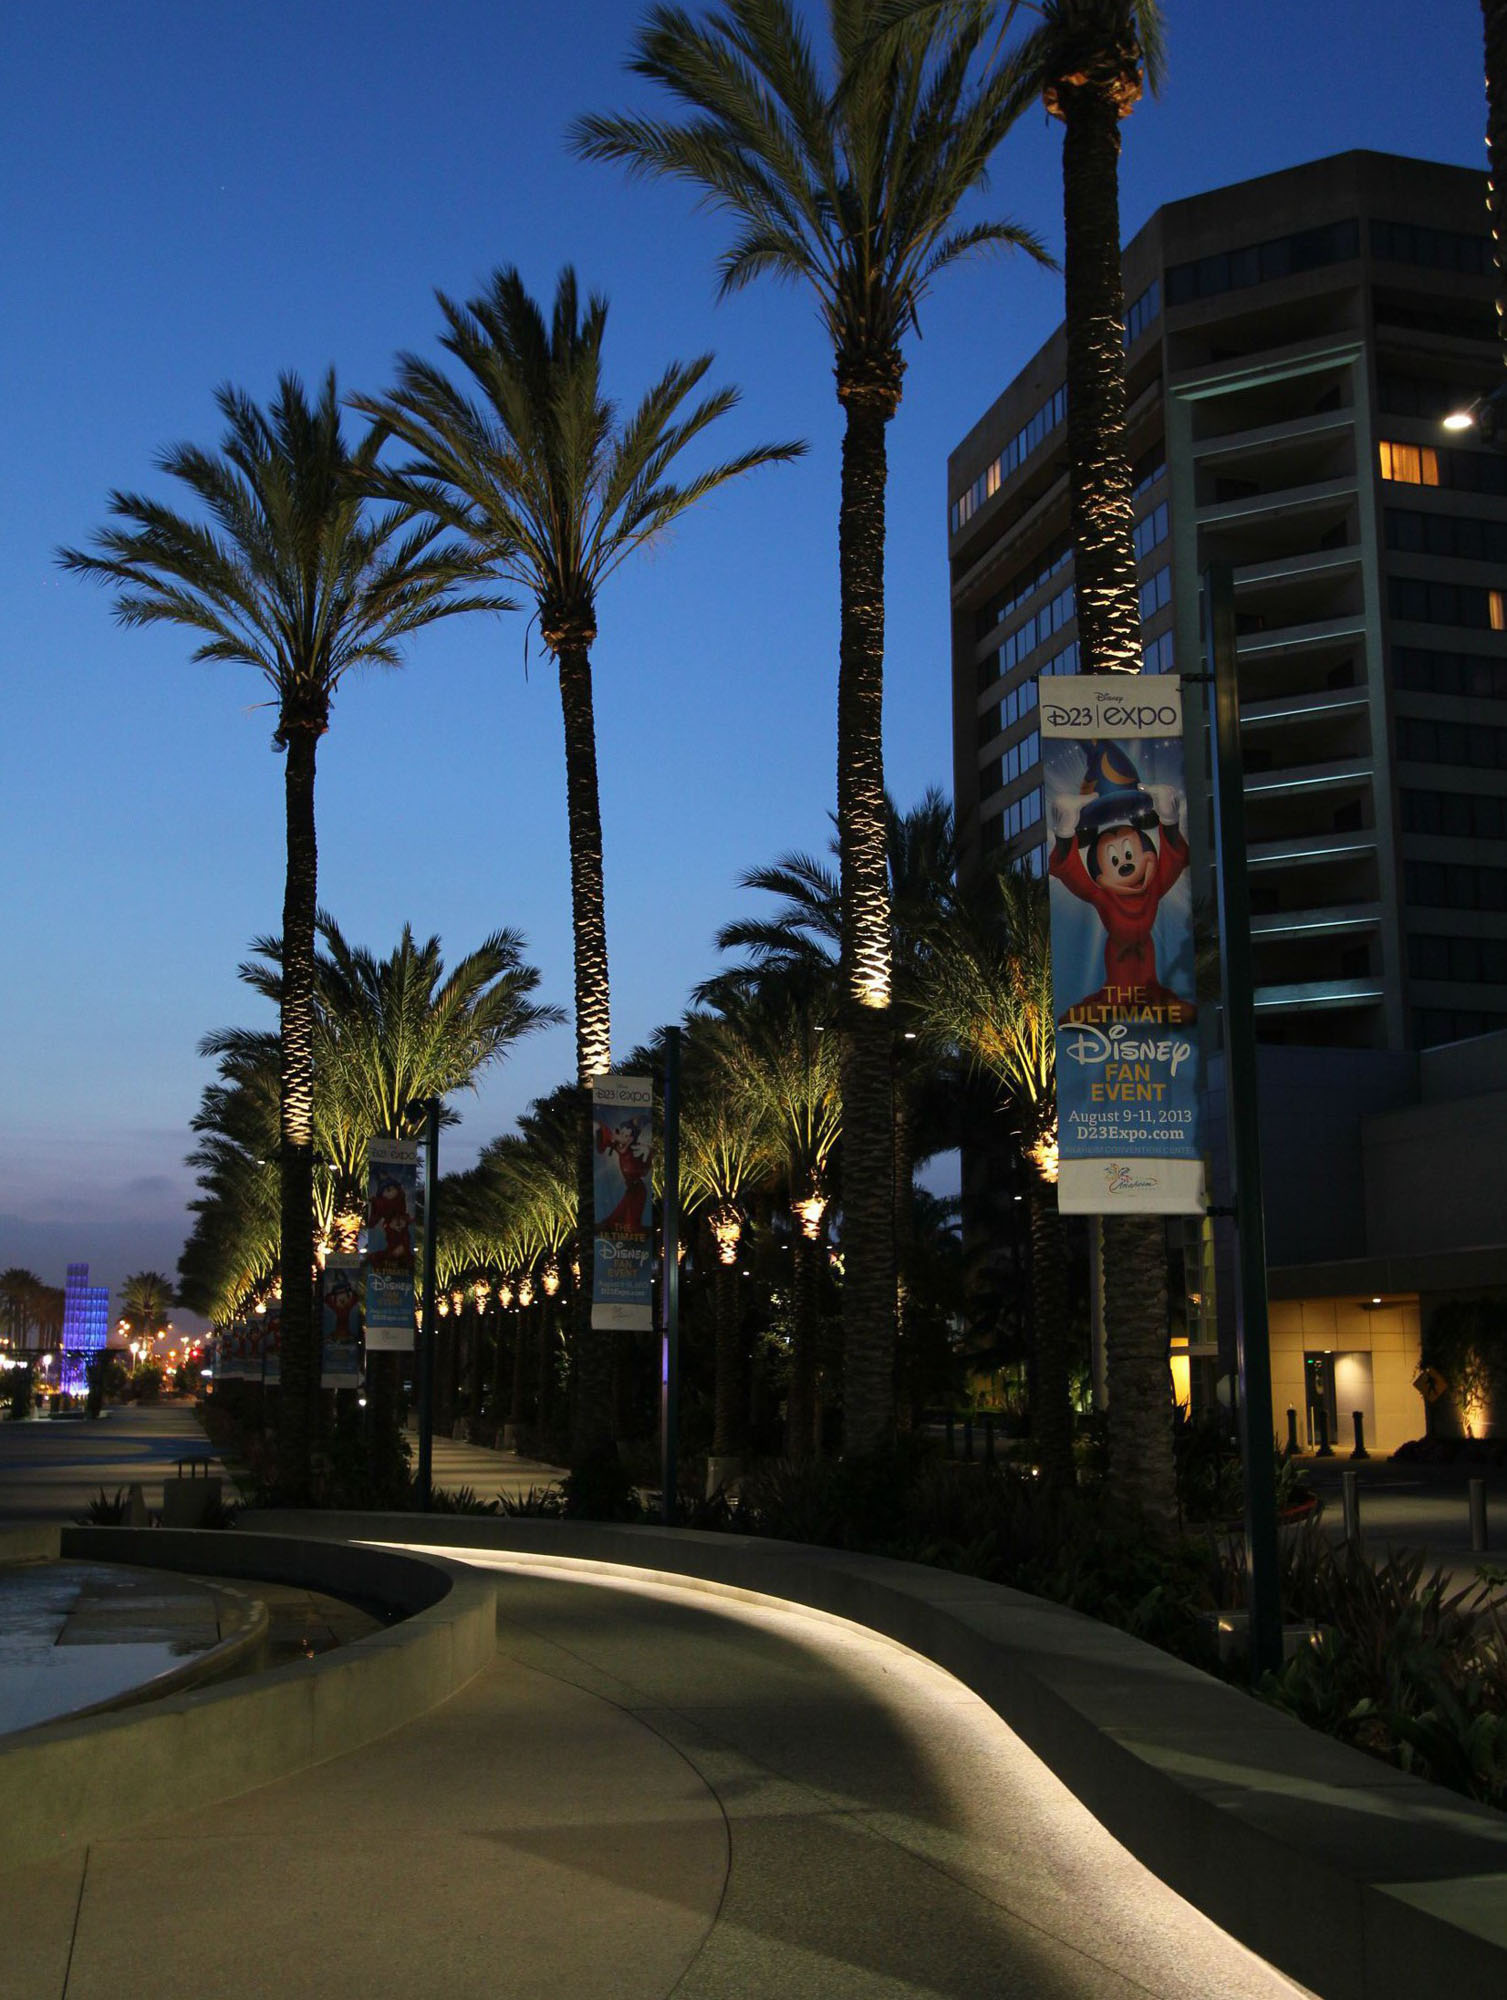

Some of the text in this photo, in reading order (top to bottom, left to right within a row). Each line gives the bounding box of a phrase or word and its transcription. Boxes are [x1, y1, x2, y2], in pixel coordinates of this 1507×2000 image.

[1094, 692, 1124, 703] Disney
[1043, 705, 1177, 729] D23 expo
[1104, 986, 1147, 1003] THE
[1069, 1006, 1183, 1024] ULTIMATE
[1058, 1022, 1191, 1077] Disney
[1105, 1064, 1150, 1082] FAN
[619, 1090, 650, 1103] expo
[1091, 1083, 1167, 1101] EVENT
[1068, 1109, 1192, 1125] August 9-11, 2013
[1077, 1126, 1185, 1142] D23Expo.com
[600, 1232, 647, 1241] ULTIMATE
